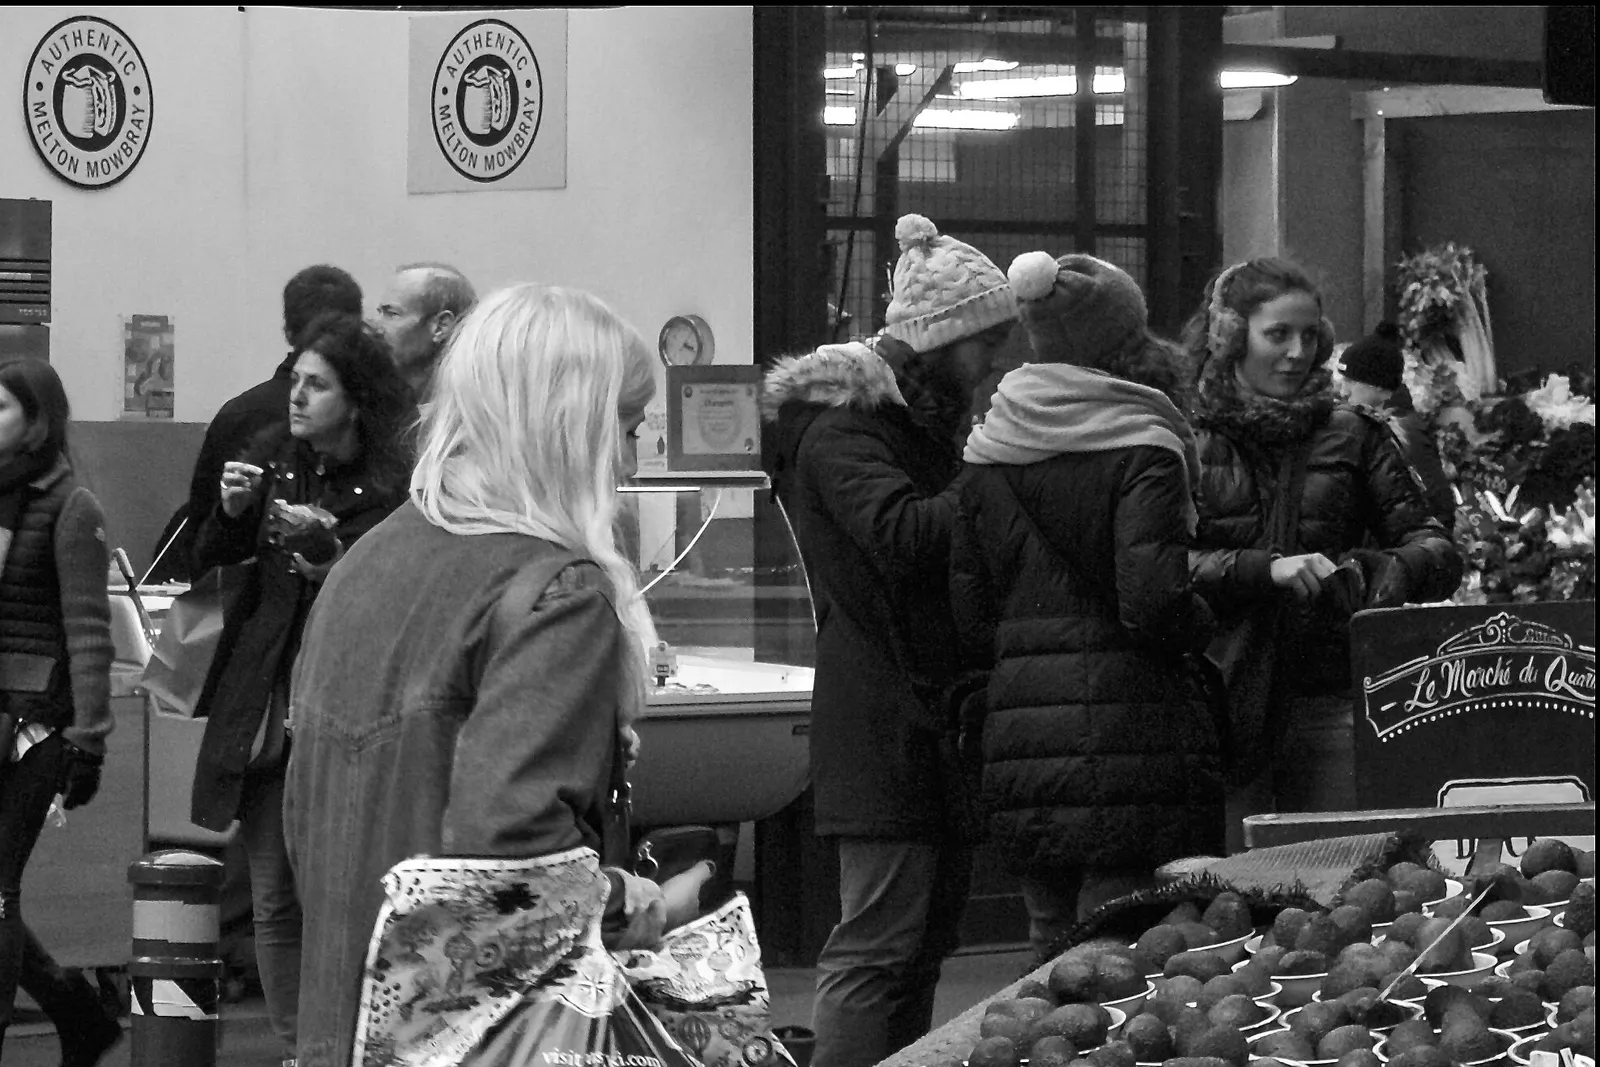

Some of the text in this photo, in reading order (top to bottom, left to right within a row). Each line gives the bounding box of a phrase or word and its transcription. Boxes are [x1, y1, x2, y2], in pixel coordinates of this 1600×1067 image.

[41, 29, 136, 76] AUTHENTIC
[446, 31, 528, 79] AUTHENTIC
[33, 101, 146, 178] MELTON MOWBRAY
[439, 97, 535, 172] MELTON MOWBRAY
[1404, 667, 1439, 713] Le
[1439, 656, 1512, 699] Marché
[1518, 655, 1540, 684] du
